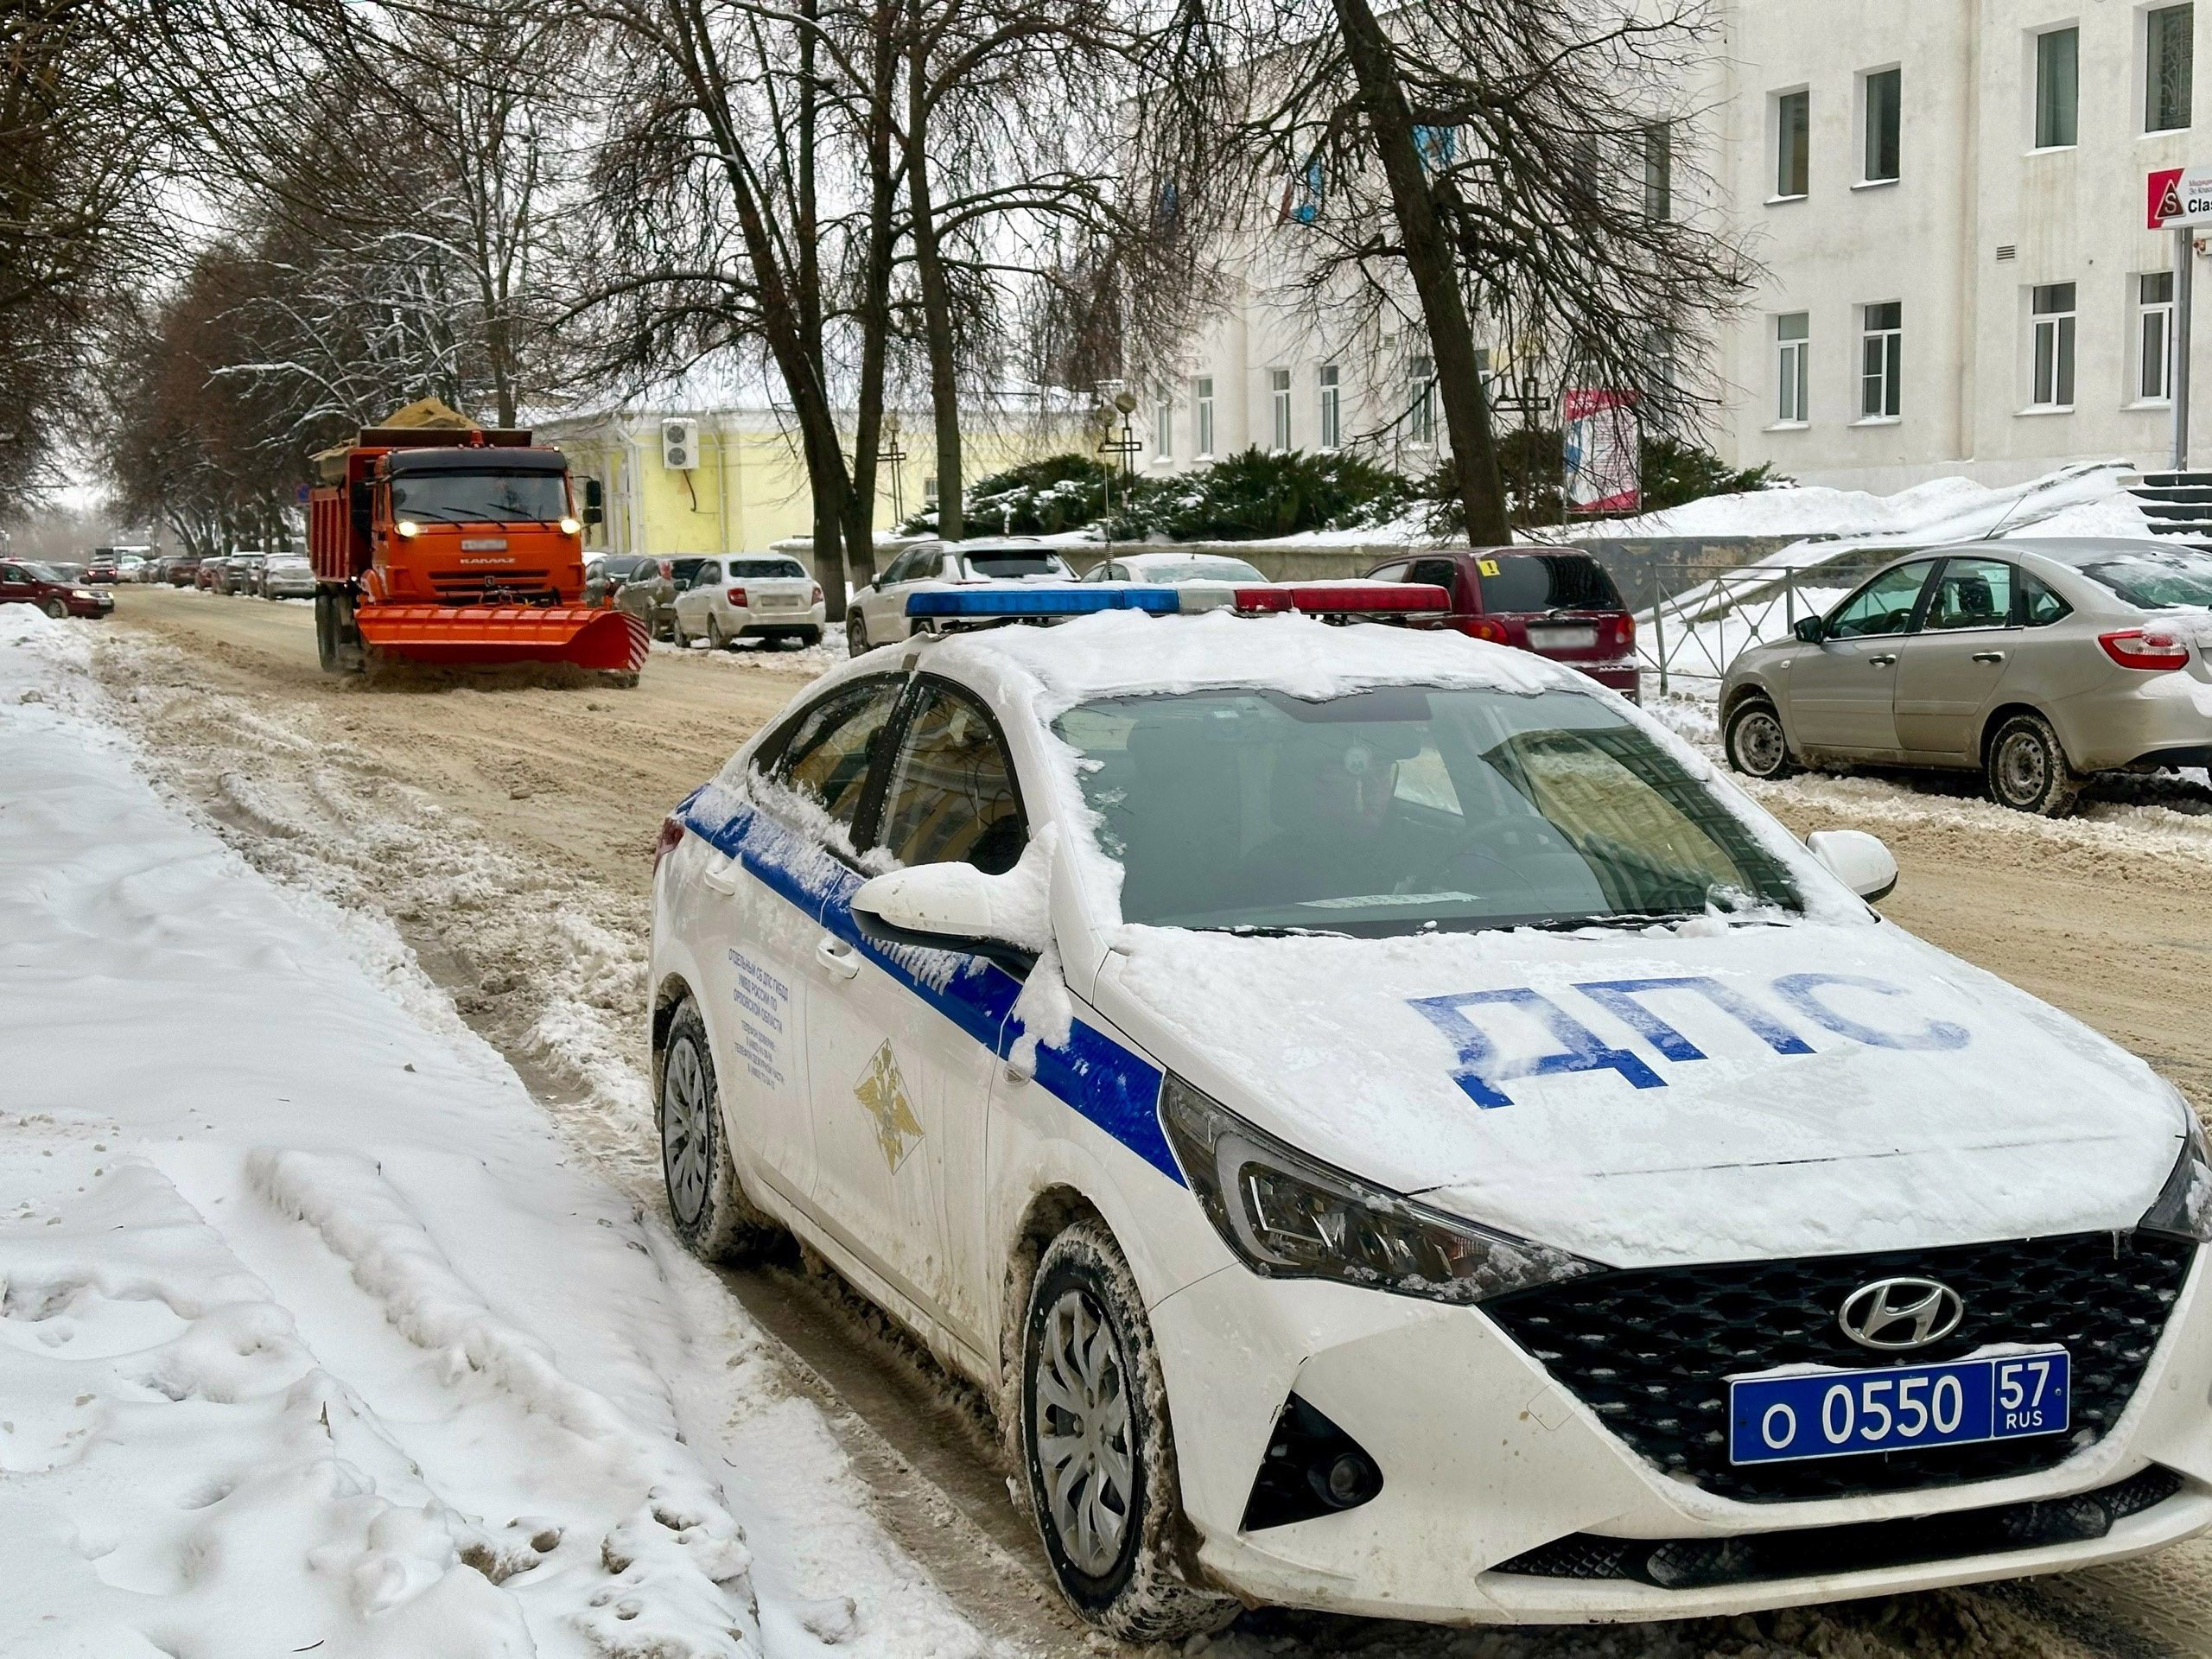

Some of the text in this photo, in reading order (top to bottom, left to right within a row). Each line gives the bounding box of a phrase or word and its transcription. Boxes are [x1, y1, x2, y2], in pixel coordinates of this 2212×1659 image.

[2188, 198, 2212, 213] Cla
[751, 982, 770, 1005] РОССИИ
[762, 971, 772, 989] ДПС
[773, 978, 788, 1002] ГИБДД
[734, 988, 782, 1034] ОРЛОВСКОЙ ОБЛАСТИ
[1406, 972, 1971, 1109] ДПС
[1822, 1375, 1963, 1445] 0550
[2000, 1361, 2050, 1409] 57
[2006, 1410, 2043, 1429] RUS
